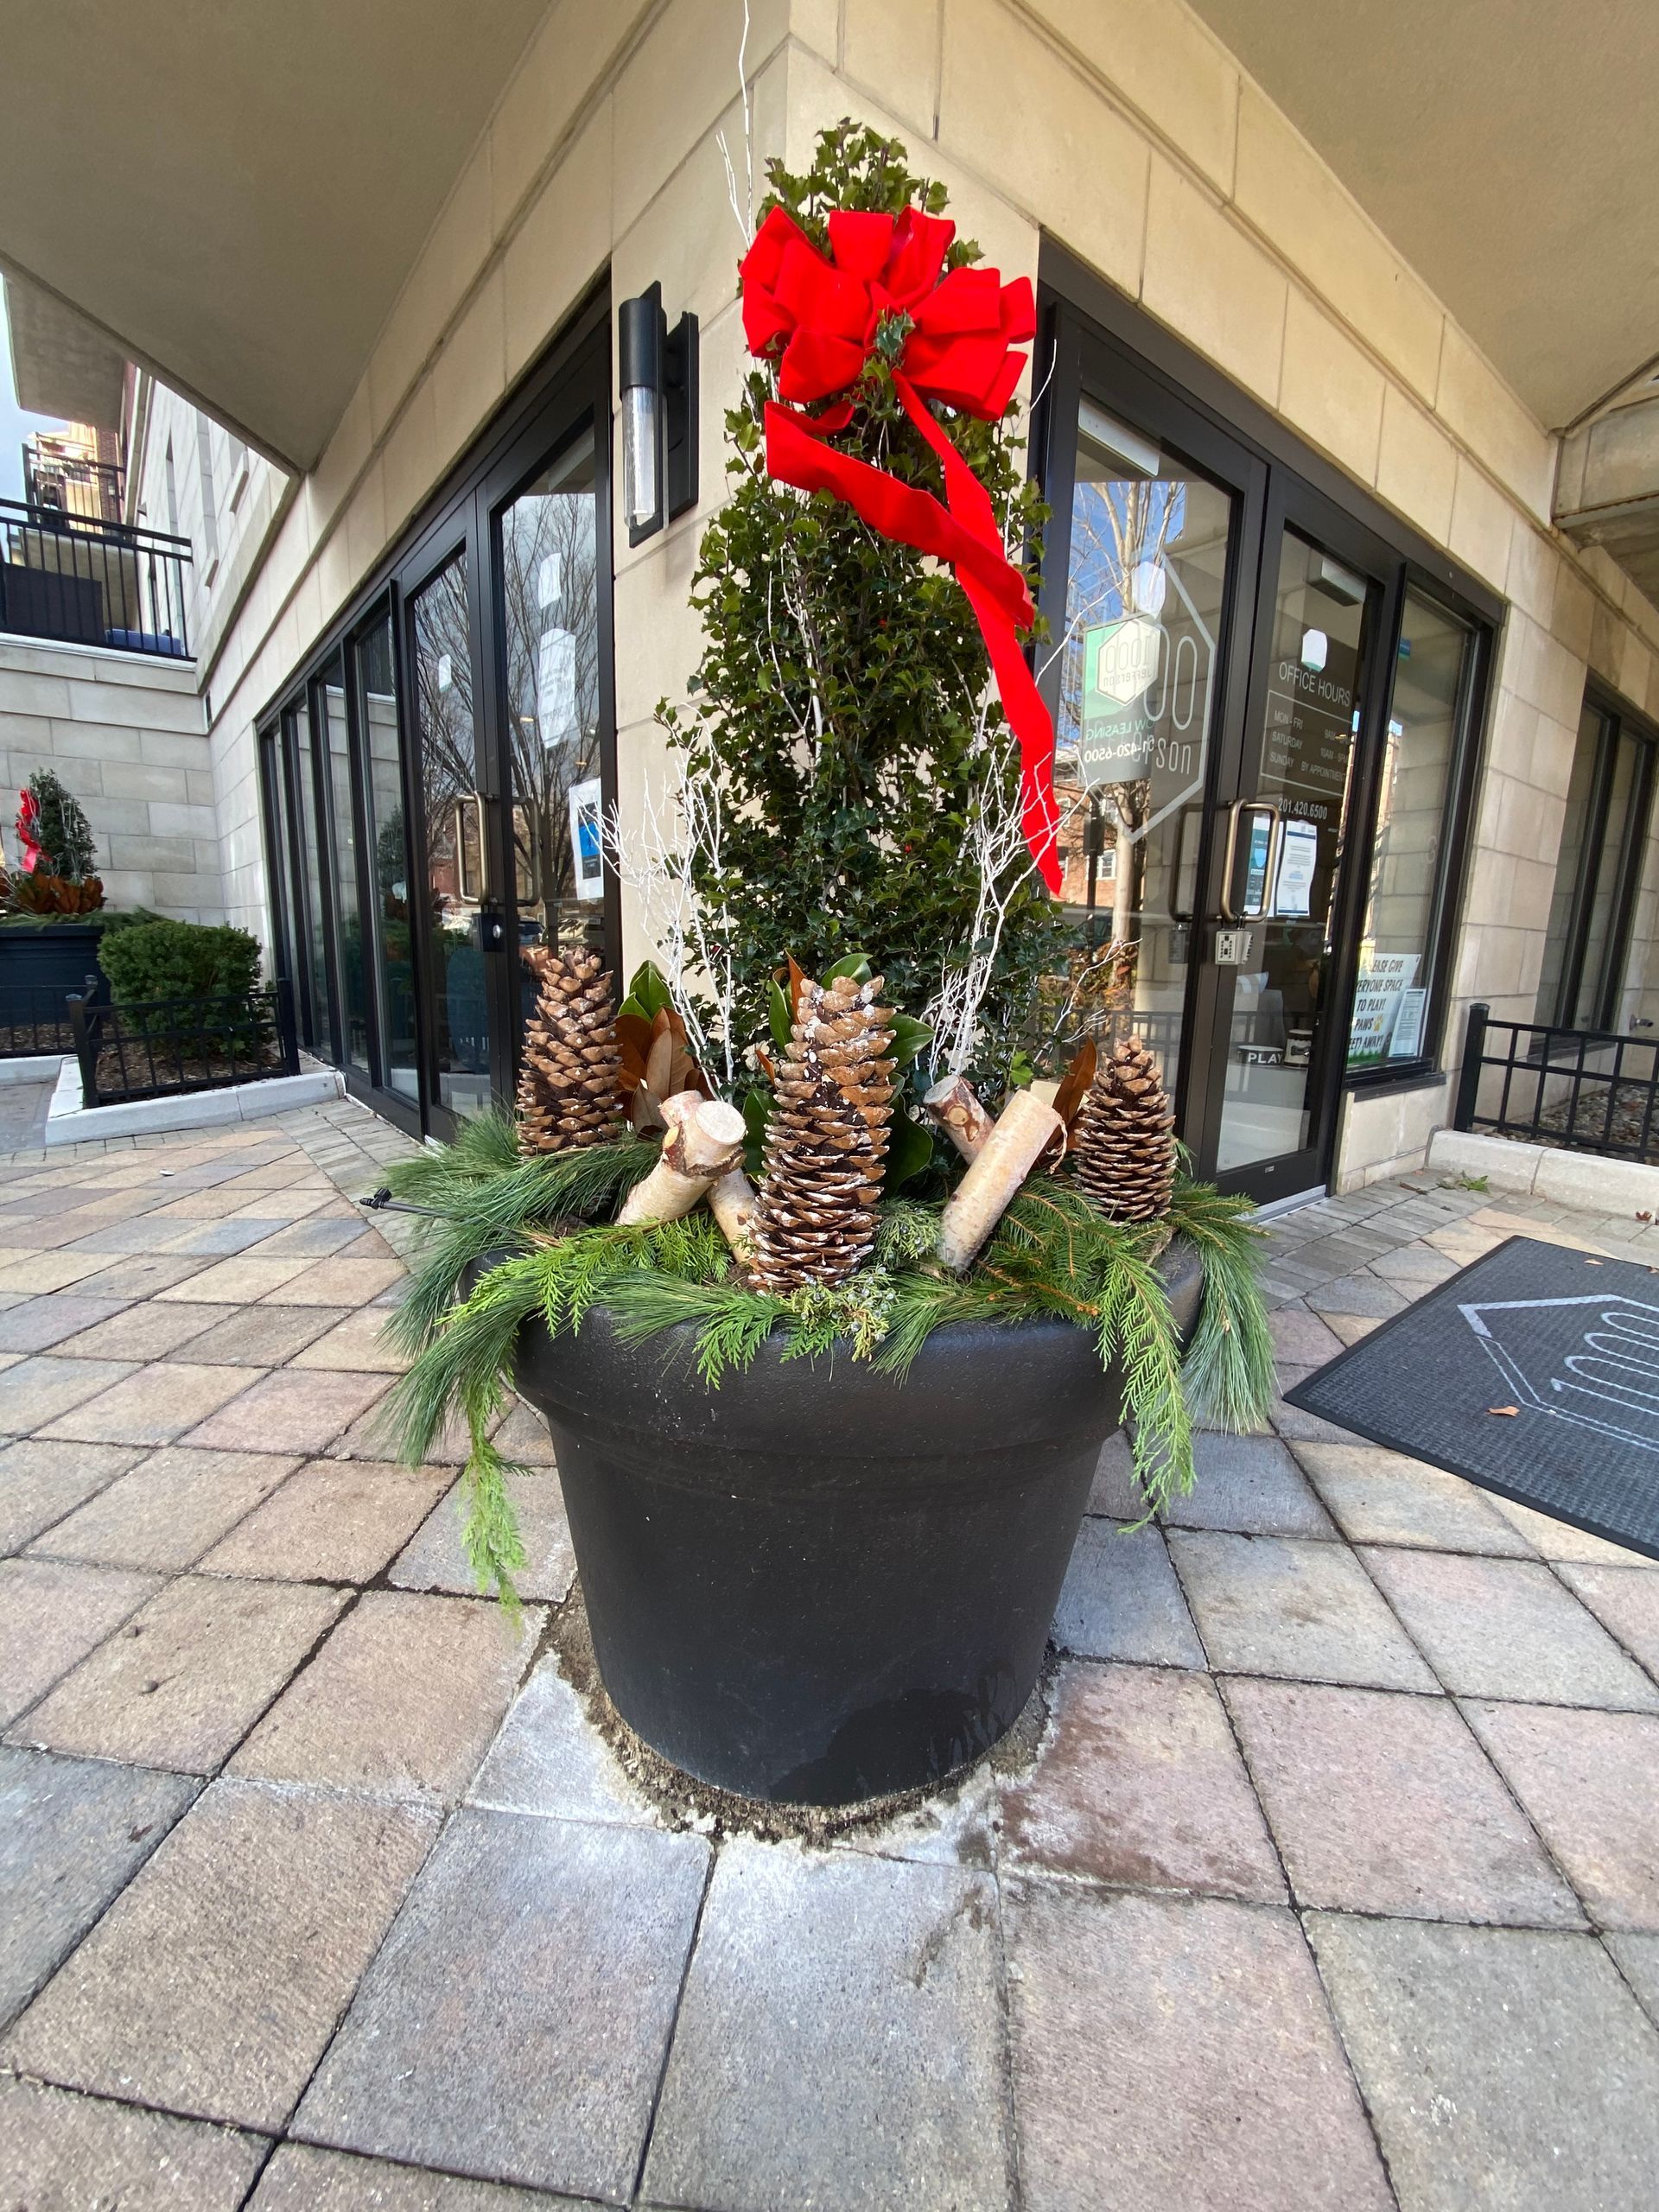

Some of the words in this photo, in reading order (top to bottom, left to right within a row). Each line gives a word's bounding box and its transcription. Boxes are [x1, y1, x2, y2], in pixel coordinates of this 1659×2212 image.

[1279, 662, 1315, 693] OFFICE
[1318, 678, 1351, 707] HOURS
[1274, 710, 1289, 726] MON
[1293, 717, 1303, 730] FRI
[1272, 731, 1303, 750] SATURDAY
[1270, 752, 1294, 768] SUNDAY
[1301, 761, 1309, 772] BY
[1278, 798, 1327, 820] 201.420.6500
[1368, 959, 1388, 973] EASE
[1388, 959, 1403, 973] GIVE
[1357, 979, 1383, 993] ERYONE
[1383, 979, 1403, 992] SPACE
[1357, 999, 1367, 1012] TO
[1367, 998, 1387, 1012] PLAY!
[1354, 1018, 1373, 1032] PAWS
[1363, 1034, 1383, 1049] AWAY!
[1247, 1052, 1283, 1064] PLAY
